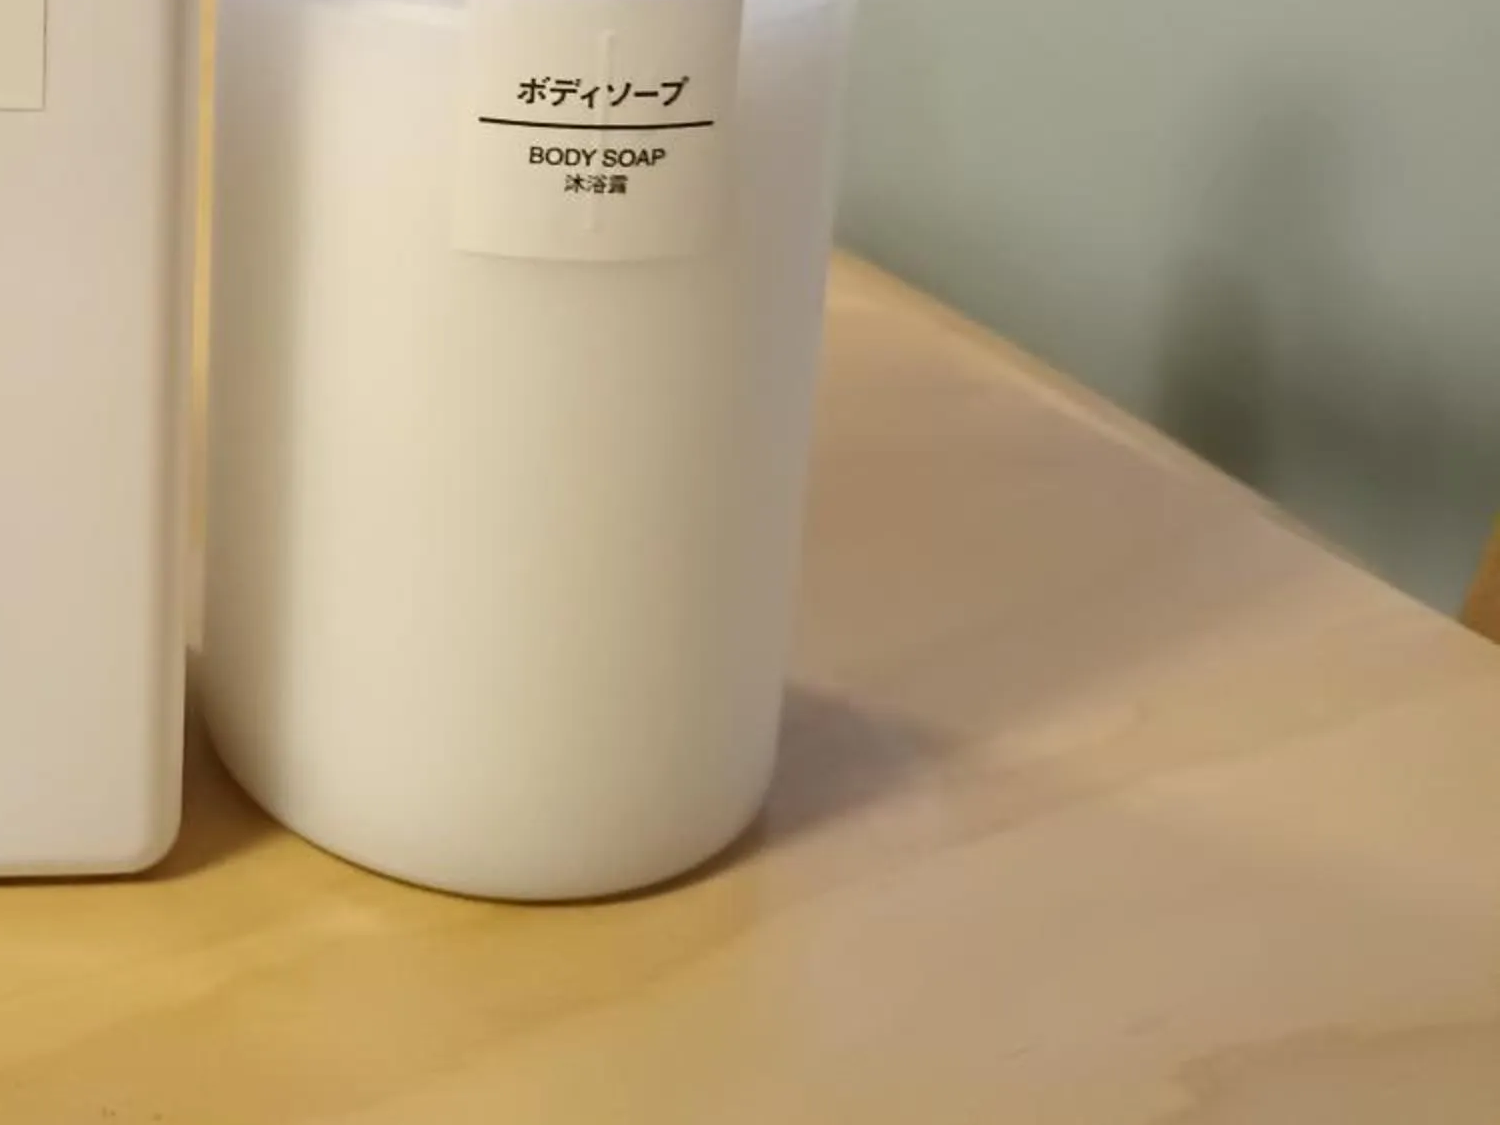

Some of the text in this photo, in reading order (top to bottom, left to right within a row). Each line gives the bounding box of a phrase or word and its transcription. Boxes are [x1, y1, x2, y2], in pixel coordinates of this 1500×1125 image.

[516, 75, 690, 109] ボディソープ
[528, 146, 667, 168] BODY SOAP
[563, 173, 629, 195] 沐浴露
